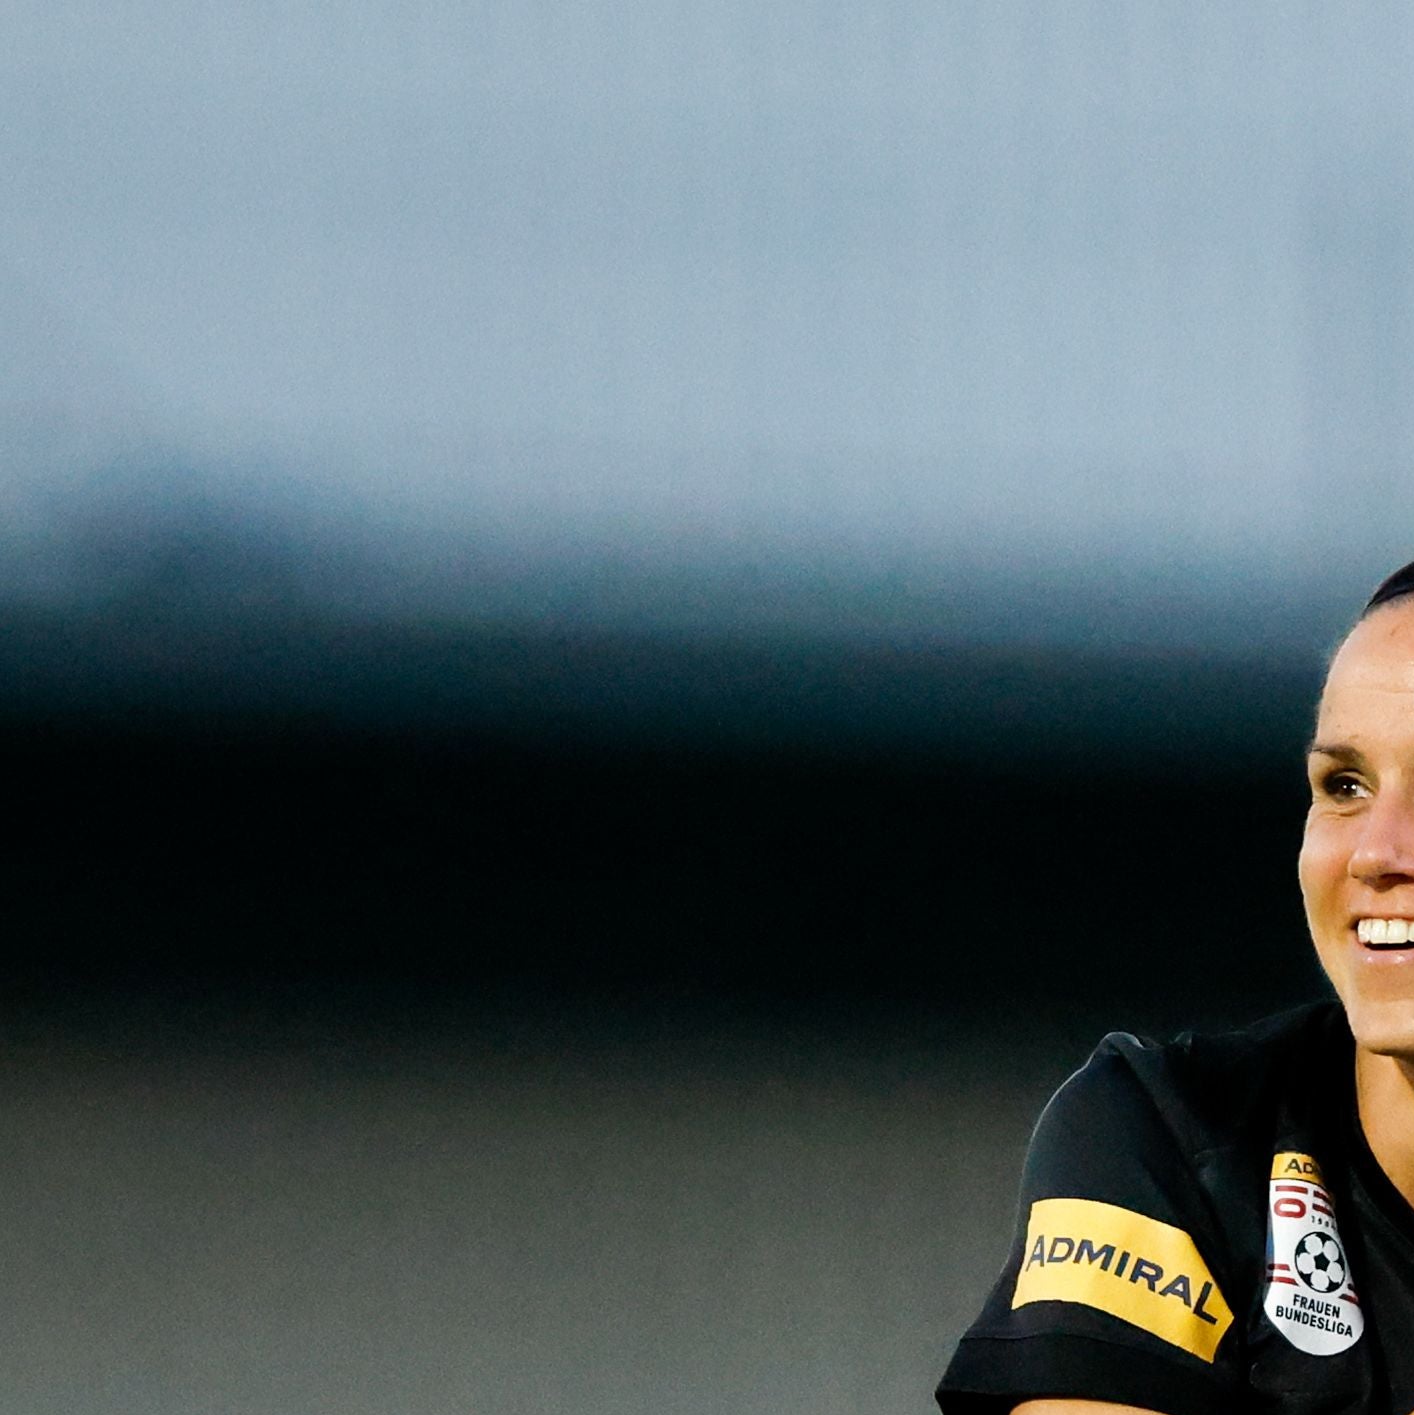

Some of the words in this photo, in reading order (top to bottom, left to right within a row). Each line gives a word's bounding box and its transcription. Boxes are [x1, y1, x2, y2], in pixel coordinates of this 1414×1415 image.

[1025, 1235, 1218, 1325] ADMIRAL
[1275, 1305, 1353, 1338] BUNDESLIGA
[1293, 1294, 1341, 1319] FRAUEN
